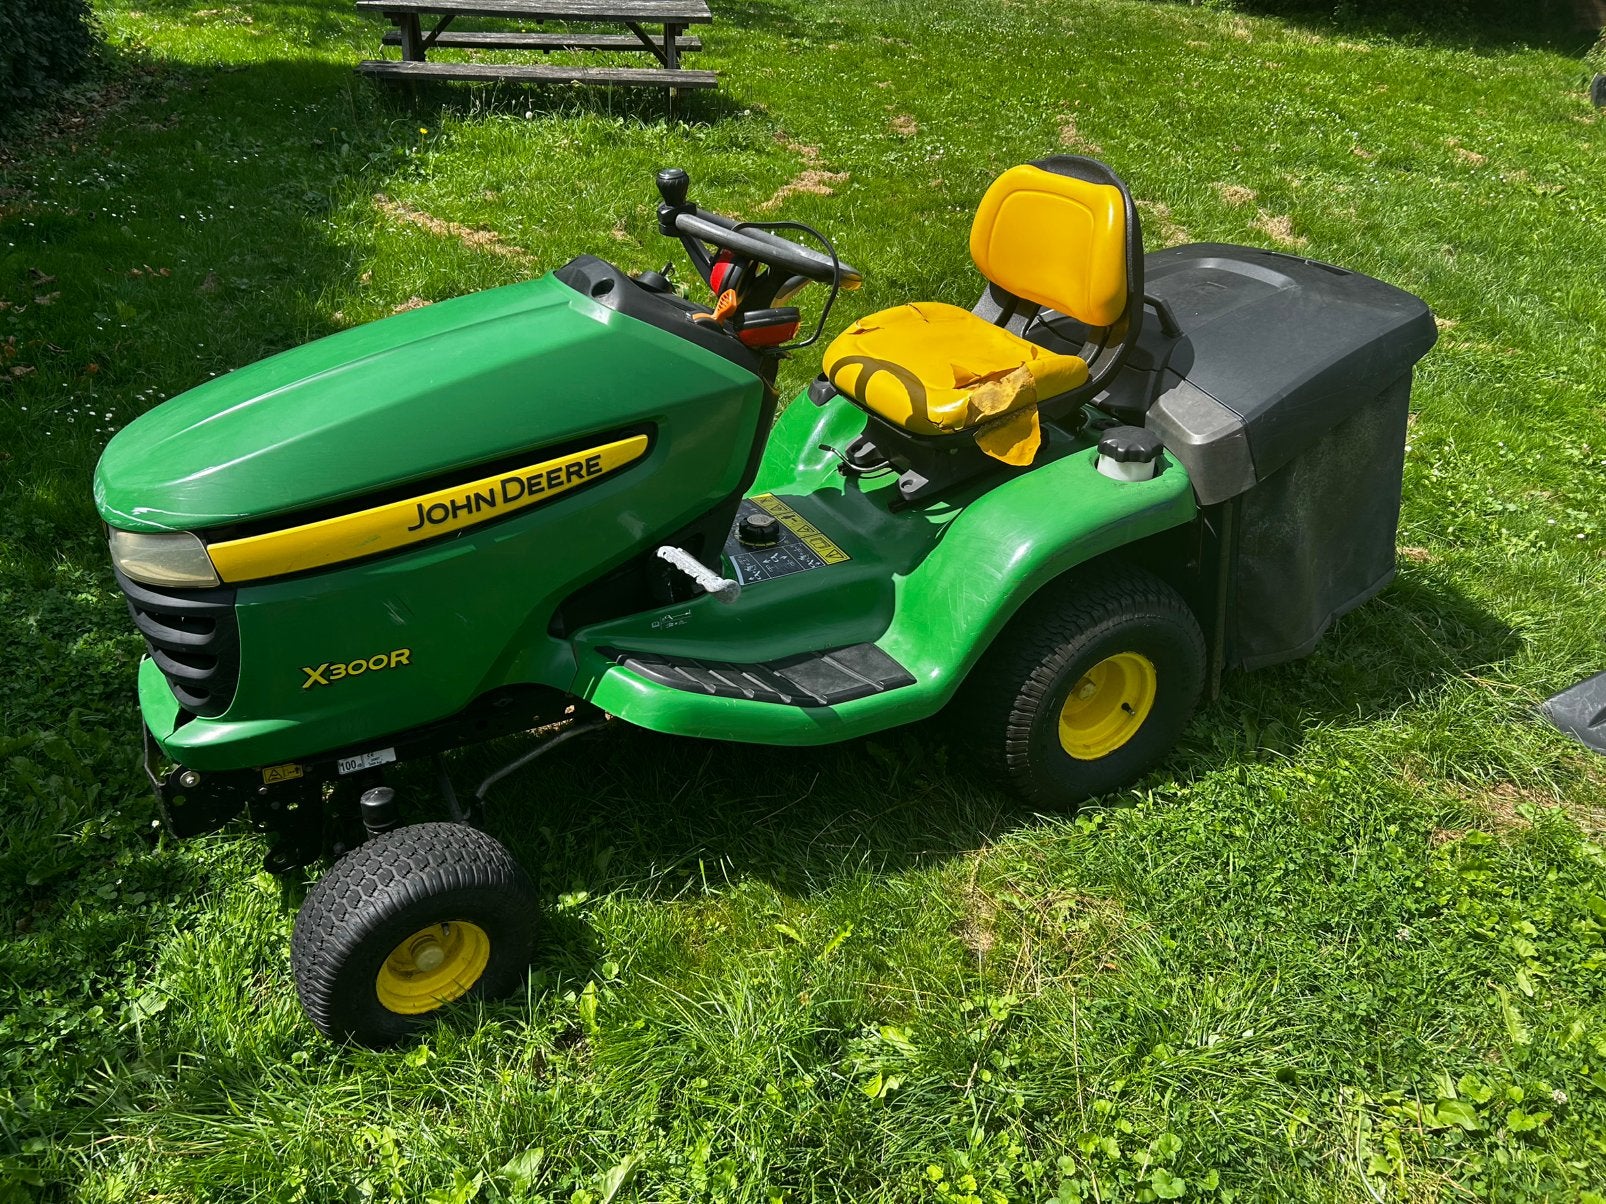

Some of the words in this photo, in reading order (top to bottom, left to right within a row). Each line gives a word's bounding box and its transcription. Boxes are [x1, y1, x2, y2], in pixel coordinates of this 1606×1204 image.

[408, 488, 496, 531] JOHN
[500, 454, 602, 504] DEERE
[302, 648, 410, 689] X300R
[340, 760, 356, 771] 100
